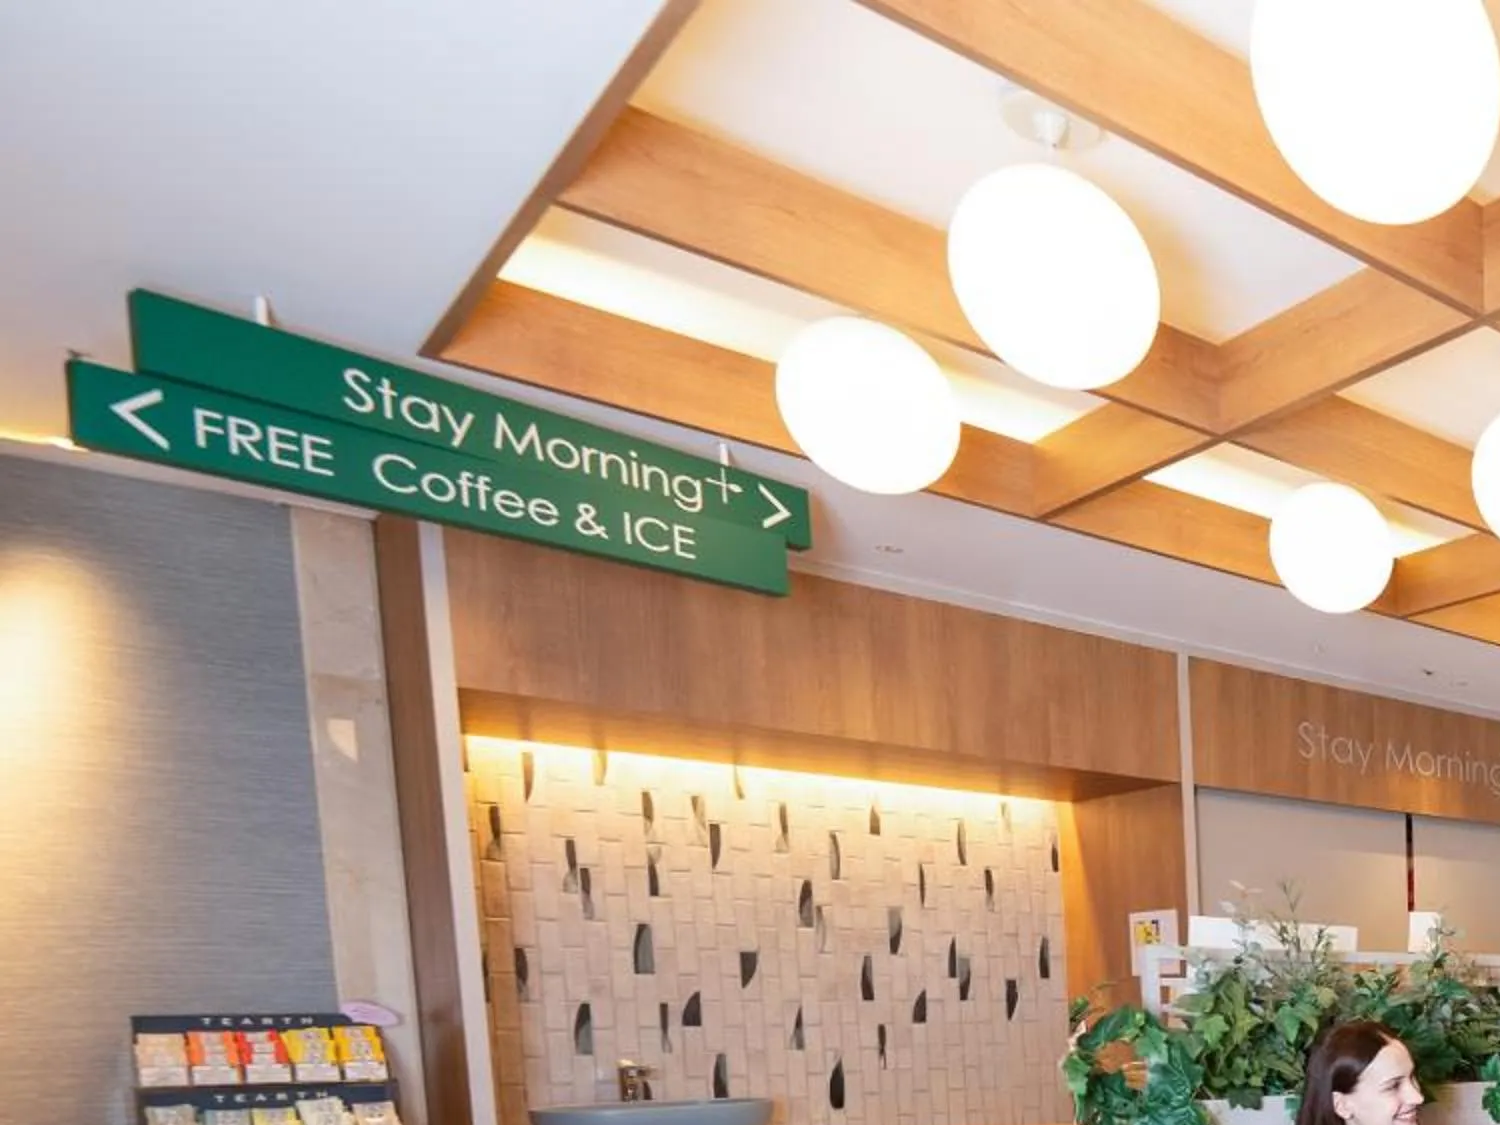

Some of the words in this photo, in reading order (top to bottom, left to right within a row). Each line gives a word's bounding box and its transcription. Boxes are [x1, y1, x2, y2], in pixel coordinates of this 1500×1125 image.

[342, 367, 476, 447] Stay
[193, 407, 335, 477] FREE
[373, 453, 560, 528] Coffee
[575, 502, 608, 540] &
[622, 511, 698, 560] ICE
[1297, 721, 1375, 775] Stay
